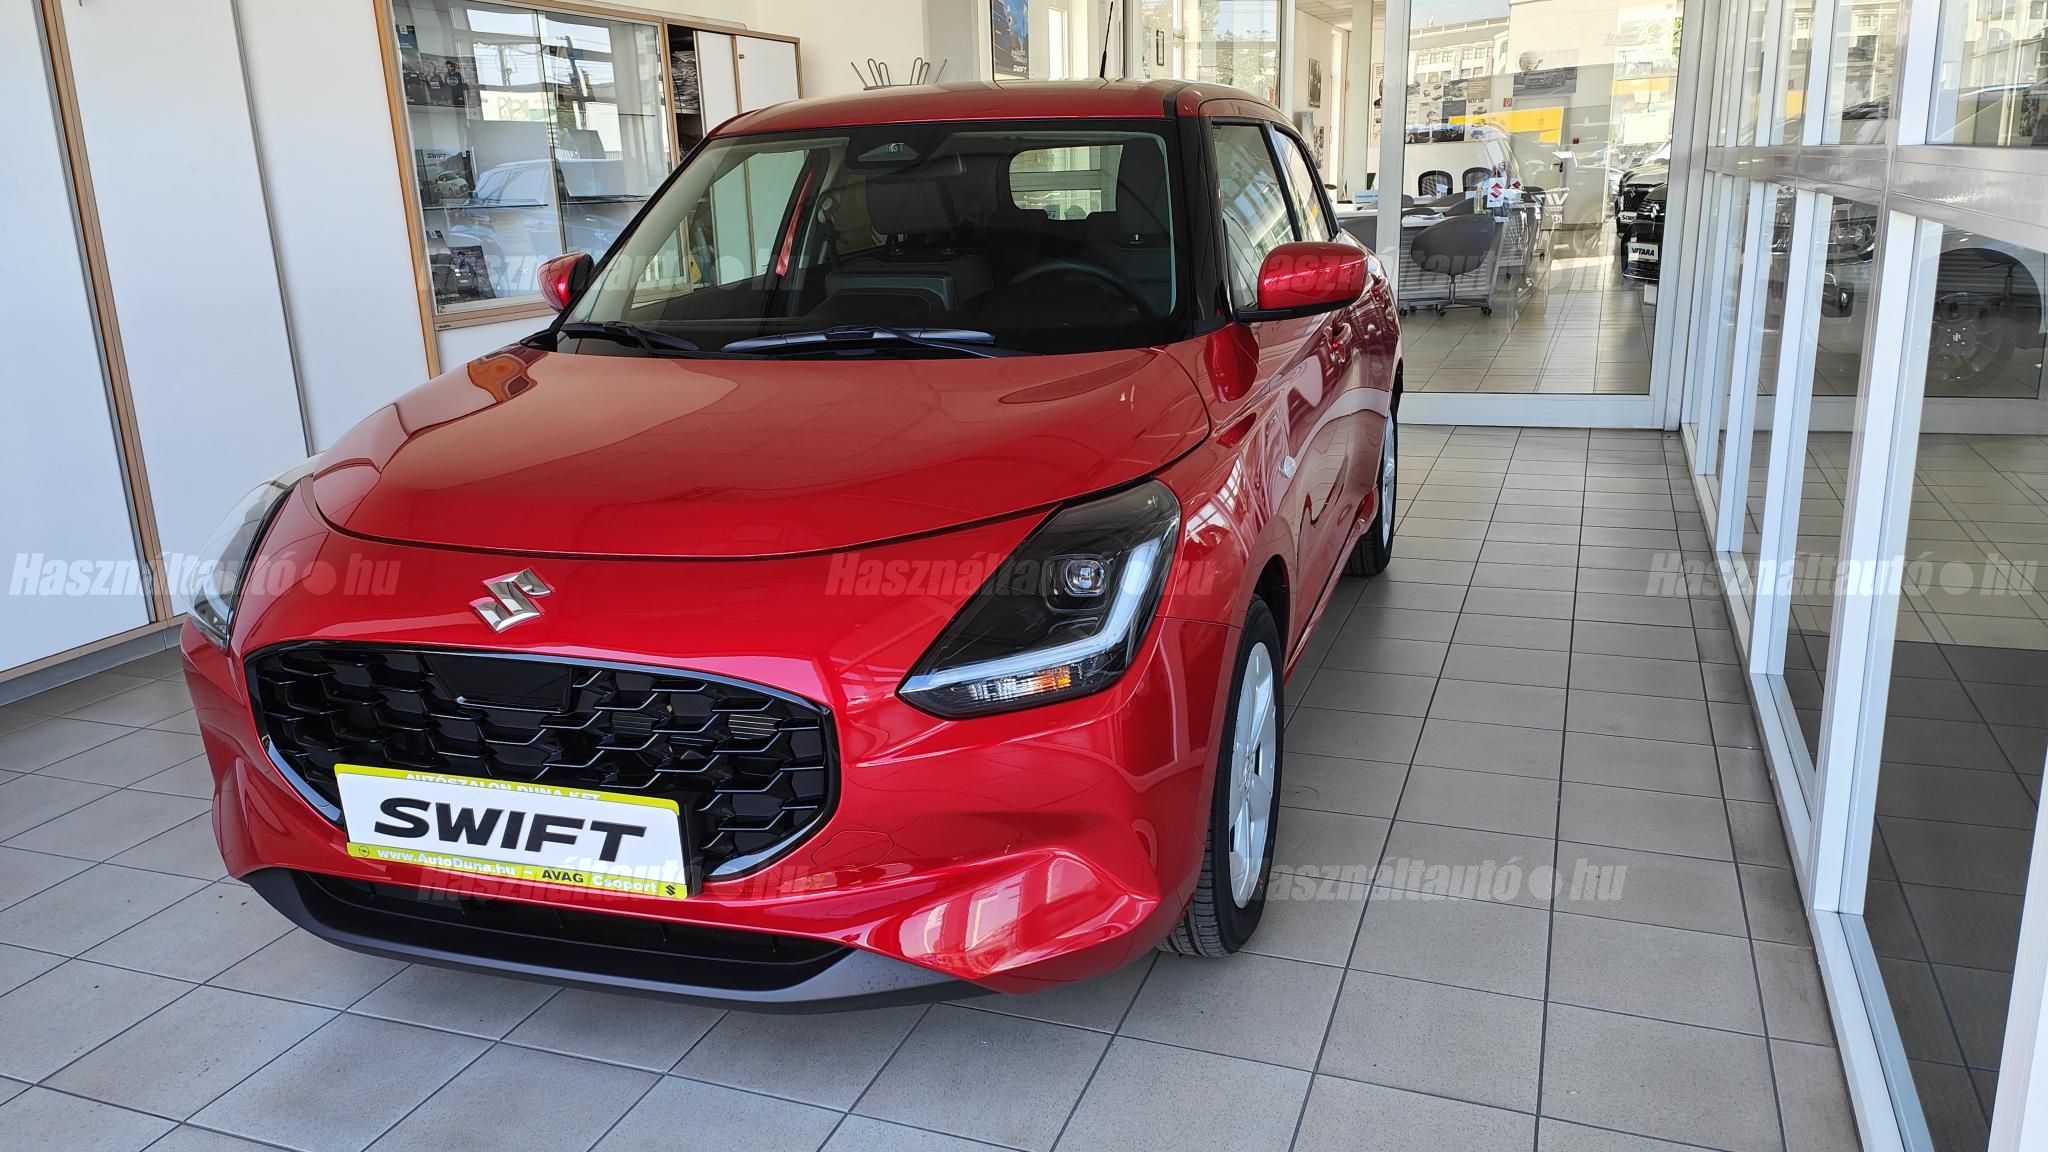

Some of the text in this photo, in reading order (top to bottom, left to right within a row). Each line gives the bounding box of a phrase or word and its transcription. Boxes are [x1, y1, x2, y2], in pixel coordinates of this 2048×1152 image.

[1632, 247, 1655, 257] VITARA
[374, 797, 647, 862] SWIFT
[376, 847, 516, 876] www.AutoDuna.hu
[541, 868, 584, 884] AVAG
[591, 875, 657, 894] Csoport
